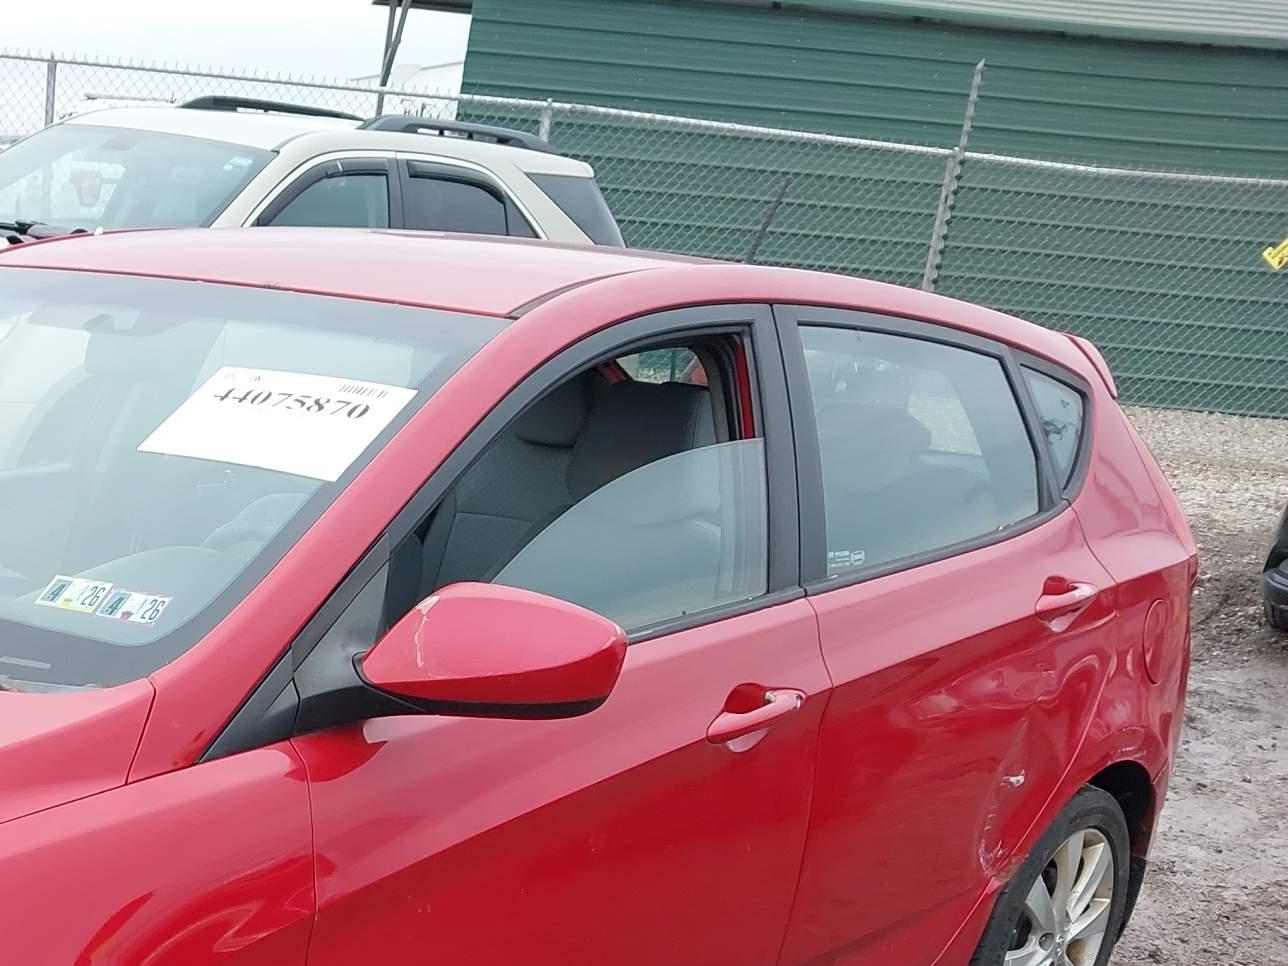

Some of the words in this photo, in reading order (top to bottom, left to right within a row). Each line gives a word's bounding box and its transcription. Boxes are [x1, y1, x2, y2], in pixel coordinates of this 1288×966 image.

[213, 387, 370, 419] 44075870
[47, 583, 67, 602] 4
[81, 586, 106, 607] 26
[105, 597, 125, 616] 4
[141, 599, 166, 621] 26
